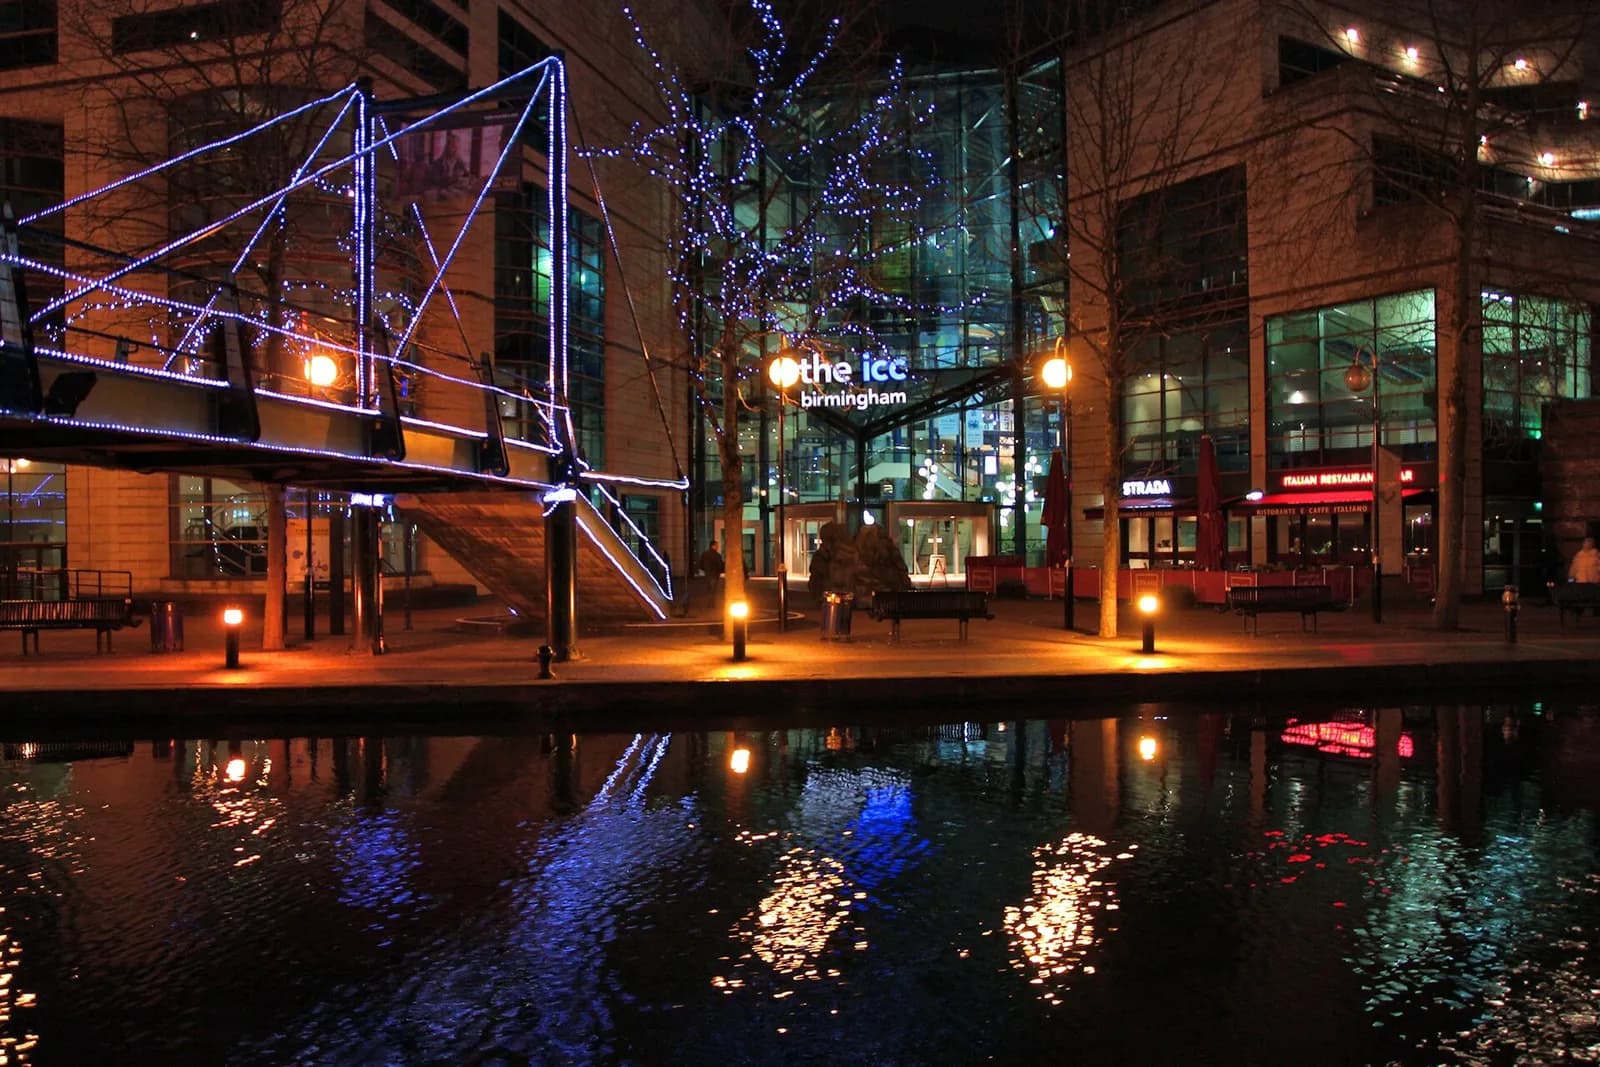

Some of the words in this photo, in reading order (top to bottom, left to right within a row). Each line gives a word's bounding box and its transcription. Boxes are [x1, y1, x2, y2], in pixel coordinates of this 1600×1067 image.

[800, 353, 852, 383] the
[862, 352, 907, 382] icc
[801, 388, 907, 410] birmingham
[1122, 479, 1171, 496] STRADA
[1283, 475, 1318, 487] ITALIAN
[1320, 471, 1374, 485] RESTAURAN
[1333, 504, 1368, 513] ITALIANO
